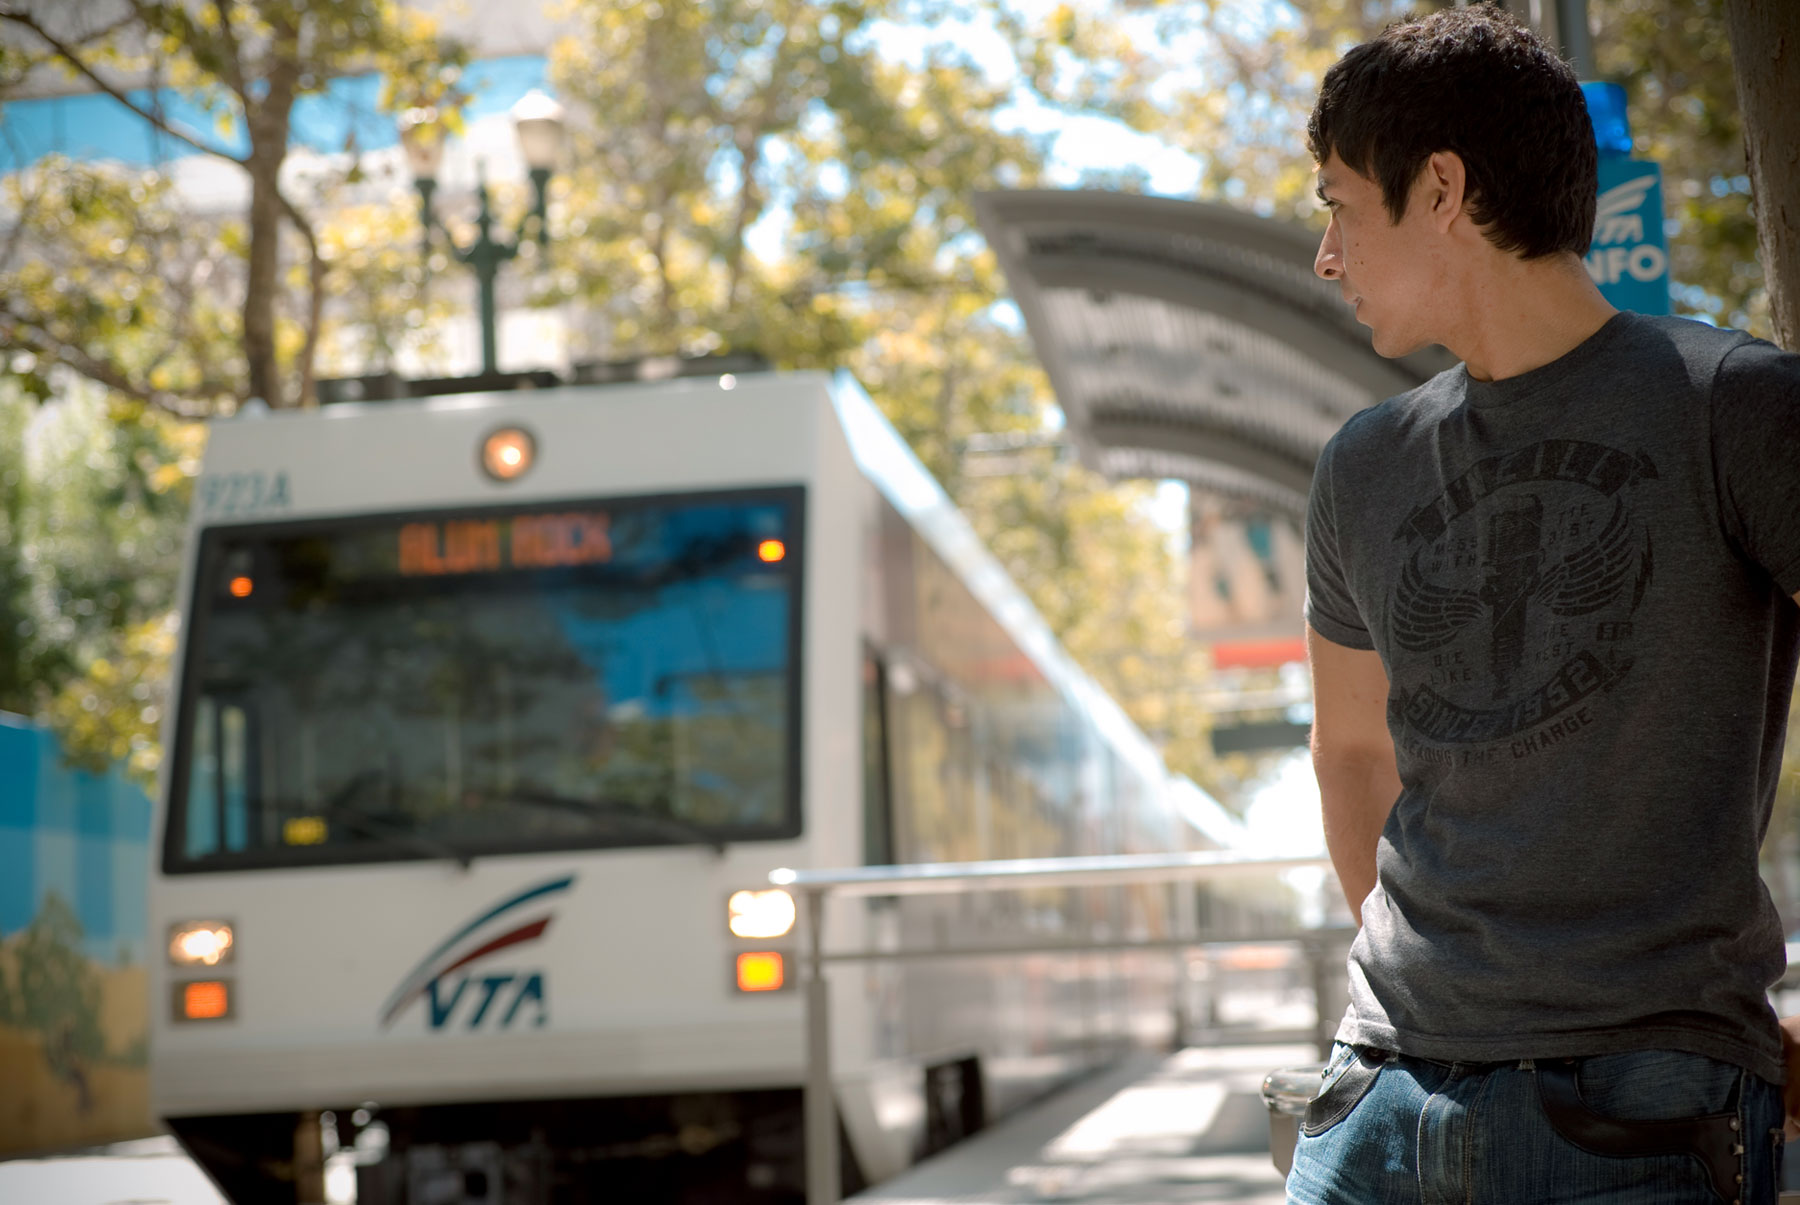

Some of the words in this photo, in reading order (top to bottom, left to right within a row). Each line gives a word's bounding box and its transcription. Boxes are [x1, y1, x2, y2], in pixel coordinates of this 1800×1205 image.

[1583, 244, 1666, 285] NFO
[1408, 690, 1489, 740] SINCE
[1511, 659, 1600, 729] 1952
[1430, 668, 1472, 685] LIKE
[1510, 705, 1594, 759] CHARGE
[426, 972, 547, 1028] VTA
